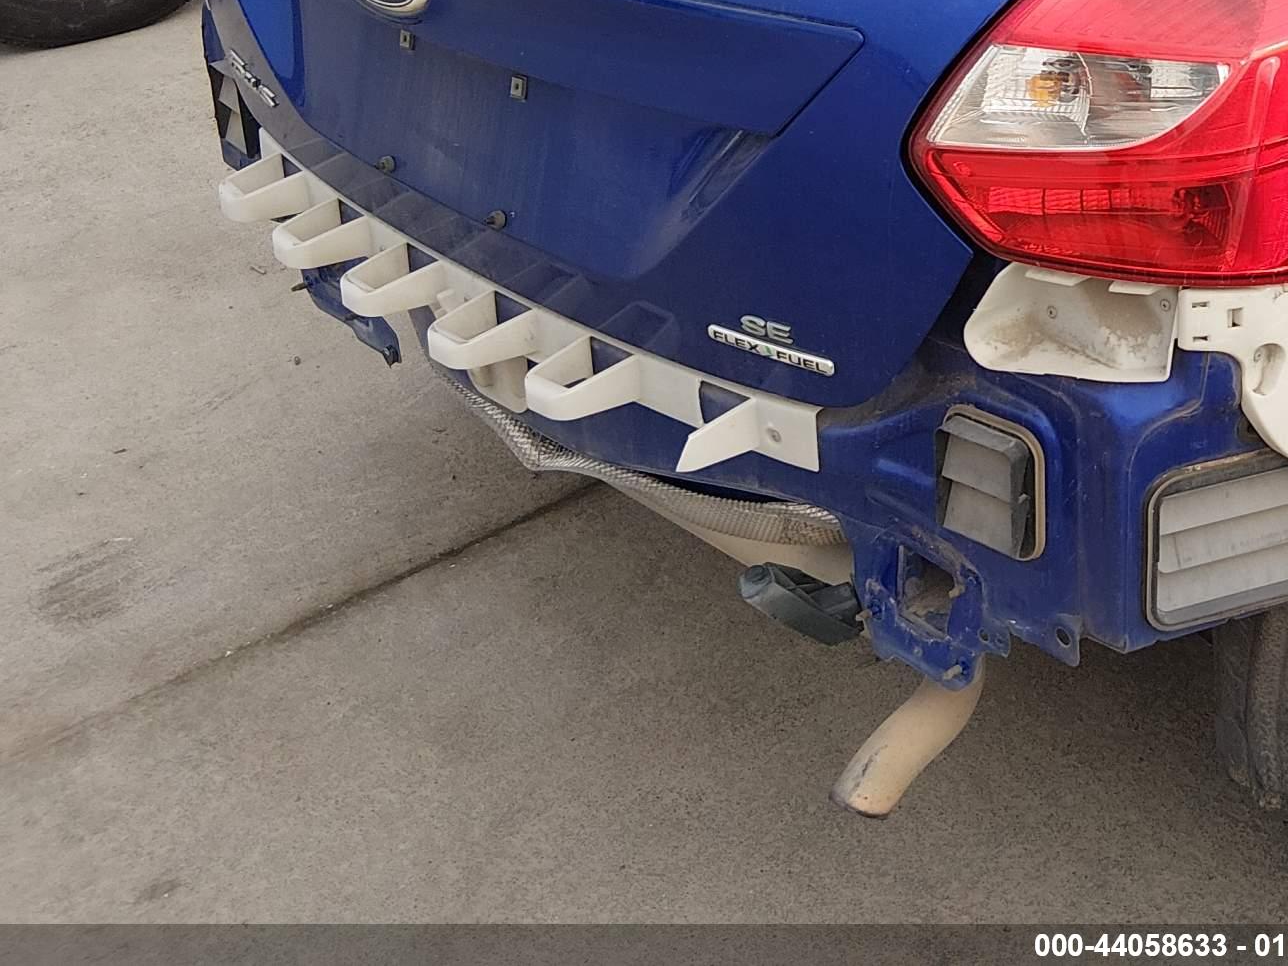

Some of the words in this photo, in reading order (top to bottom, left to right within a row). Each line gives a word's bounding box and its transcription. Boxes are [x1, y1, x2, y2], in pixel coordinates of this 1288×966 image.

[740, 314, 794, 345] SE
[712, 328, 761, 354] FLEX
[775, 349, 829, 374] FUEL
